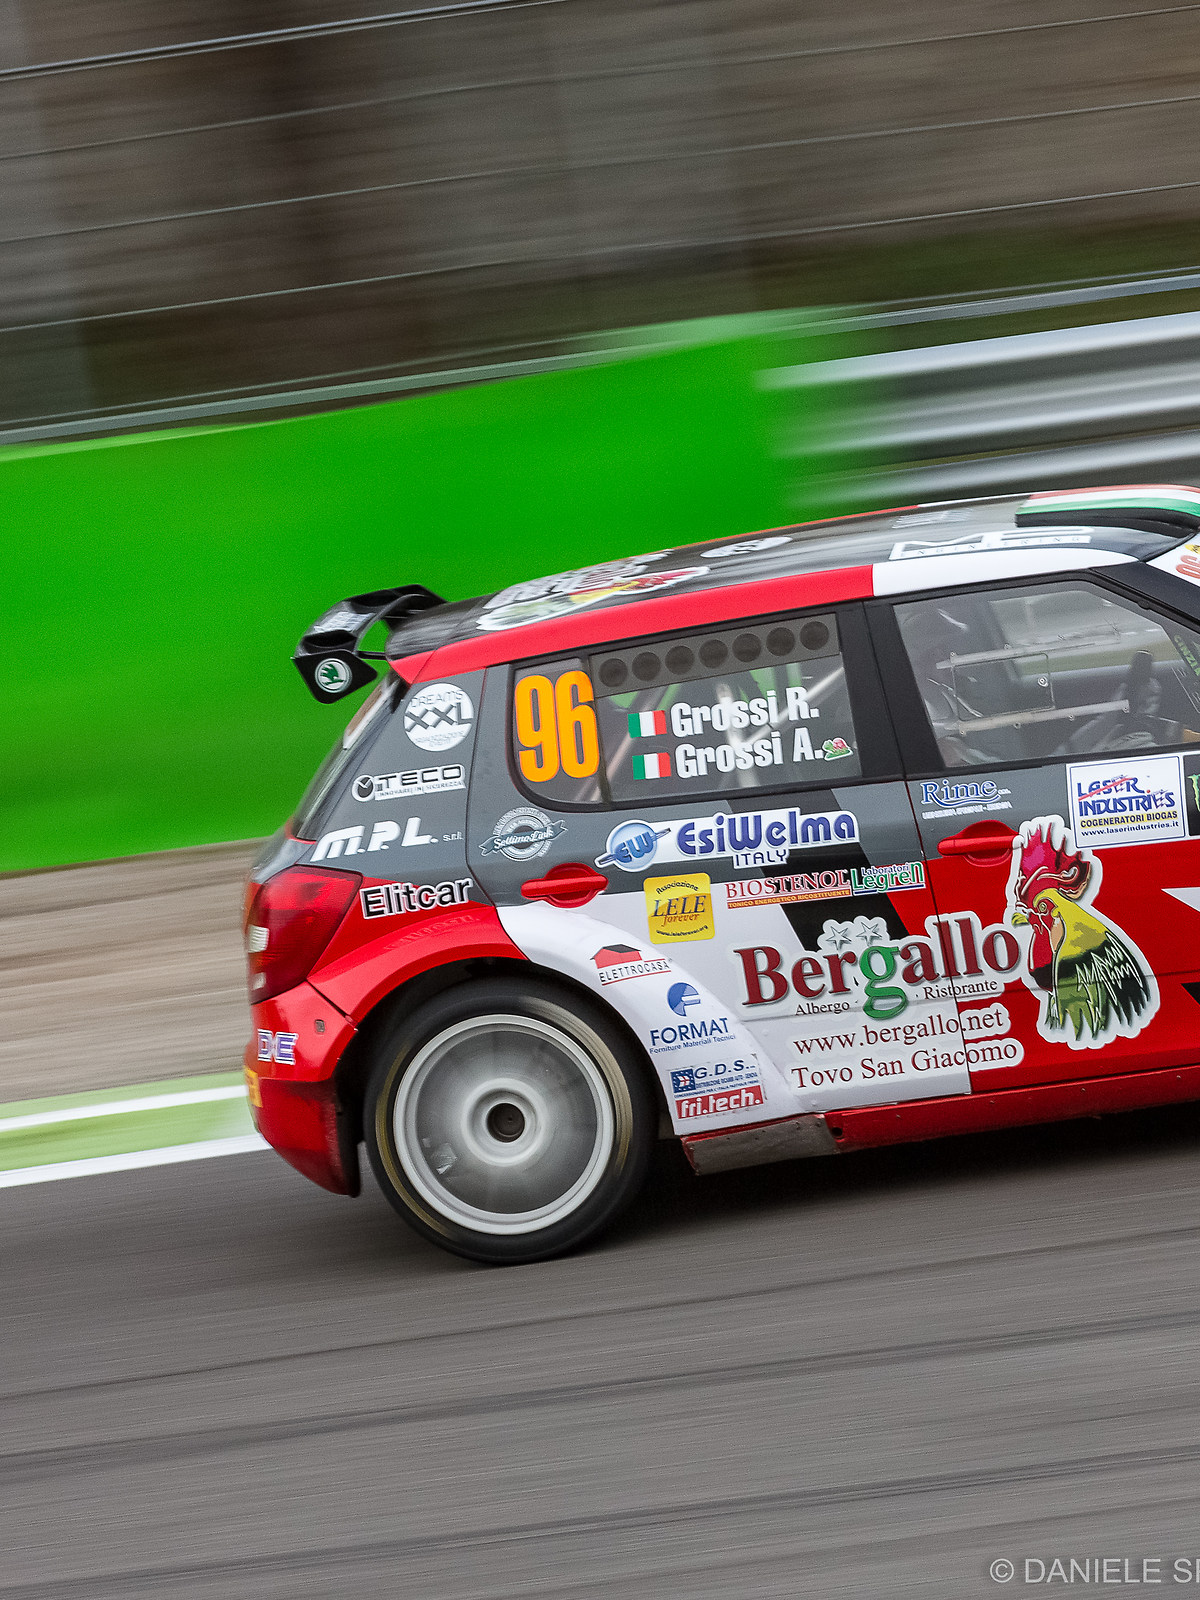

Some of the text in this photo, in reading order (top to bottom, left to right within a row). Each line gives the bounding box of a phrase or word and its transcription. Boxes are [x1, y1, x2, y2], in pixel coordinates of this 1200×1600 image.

[405, 703, 473, 732] XXL
[670, 686, 820, 738] Grossi R.
[514, 670, 599, 783] 96
[675, 727, 825, 779] Grossi A.
[920, 780, 1000, 807] Rime
[1077, 777, 1145, 797] LASER
[1079, 792, 1175, 816] INDUSTRIES
[677, 811, 856, 855] EsiWelma
[1081, 811, 1178, 828] COGENERATORI BIOGAS
[1081, 821, 1179, 837] www.laserindustries.it
[310, 817, 439, 862] M.P.L.
[735, 850, 788, 867] ITALY
[861, 863, 909, 876] Laboratori
[362, 879, 472, 918] Elitcar
[656, 880, 699, 895] Associazione
[725, 870, 849, 899] BIOSTENOL
[651, 895, 706, 917] LELE
[728, 890, 850, 908] TONICO ENERGETICO RICOSTITUENTE
[661, 914, 700, 927] forever
[598, 960, 669, 983] ELETTROCASA
[734, 917, 1020, 1020] Bergallo
[794, 979, 998, 1017] Albergo Ristorante
[649, 1034, 736, 1054] Forniture Materiali Tecnici
[650, 1017, 729, 1046] FORMAT
[793, 1010, 1004, 1055] www.bergallo.net
[694, 1060, 750, 1079] G.D.S.
[791, 1043, 1018, 1089] Tovo San Giacomo
[681, 1089, 760, 1118] fri.tech.
